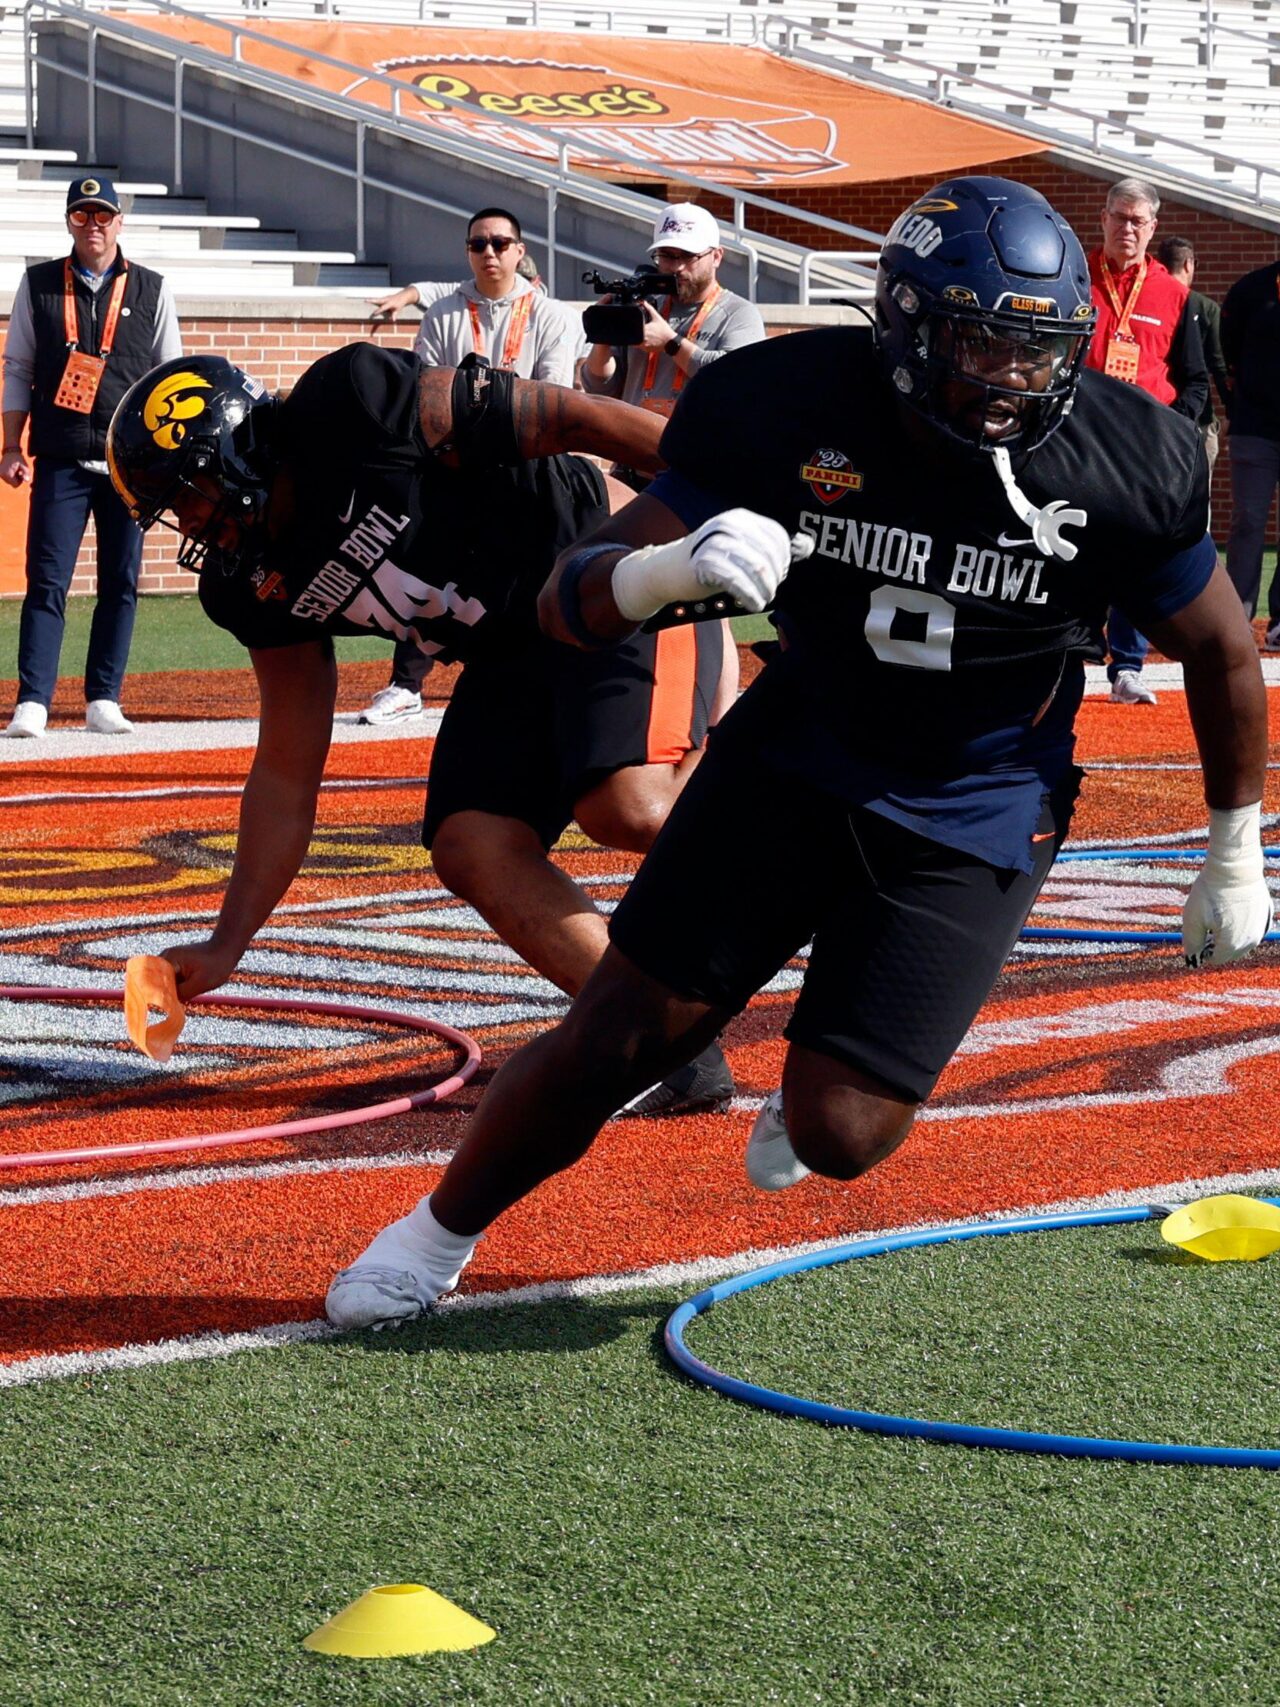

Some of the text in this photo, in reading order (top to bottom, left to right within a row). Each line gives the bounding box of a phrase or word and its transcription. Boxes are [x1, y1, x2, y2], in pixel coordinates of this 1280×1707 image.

[417, 74, 666, 116] Reese's
[435, 117, 821, 163] SENOR BOWL
[806, 467, 859, 488] PANINI
[290, 504, 411, 623] SENIOR BOWL
[799, 510, 1049, 605] SENIOR BOWL
[340, 558, 488, 656] 74
